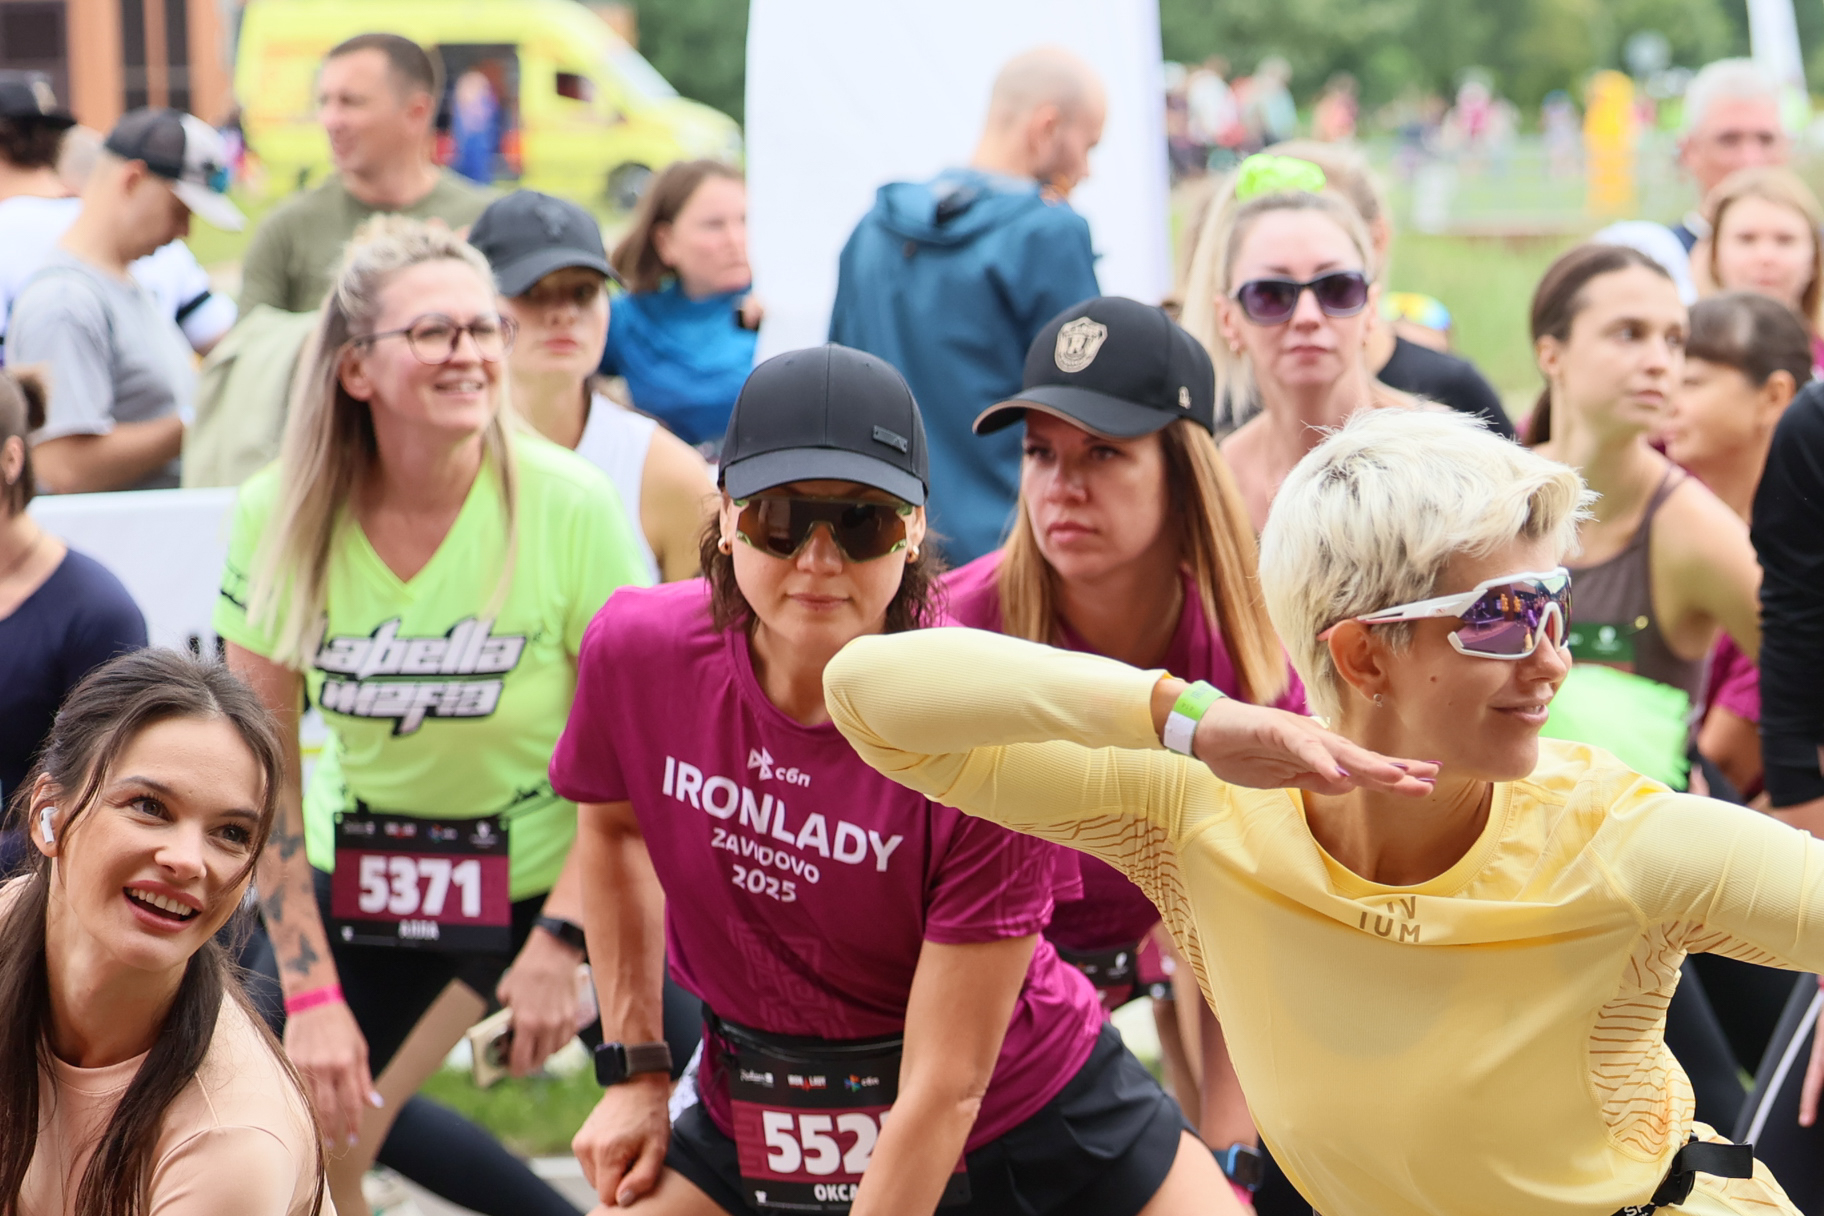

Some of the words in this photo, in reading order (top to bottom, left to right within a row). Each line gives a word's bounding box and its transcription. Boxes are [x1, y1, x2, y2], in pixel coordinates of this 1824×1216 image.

[313, 615, 527, 680] abella
[775, 767, 811, 788] сбп
[662, 755, 903, 873] IRONLADY
[358, 854, 482, 918] 5371
[711, 827, 821, 885] ZAVIDOVO
[732, 863, 797, 903] 2025
[762, 1110, 894, 1175] 552
